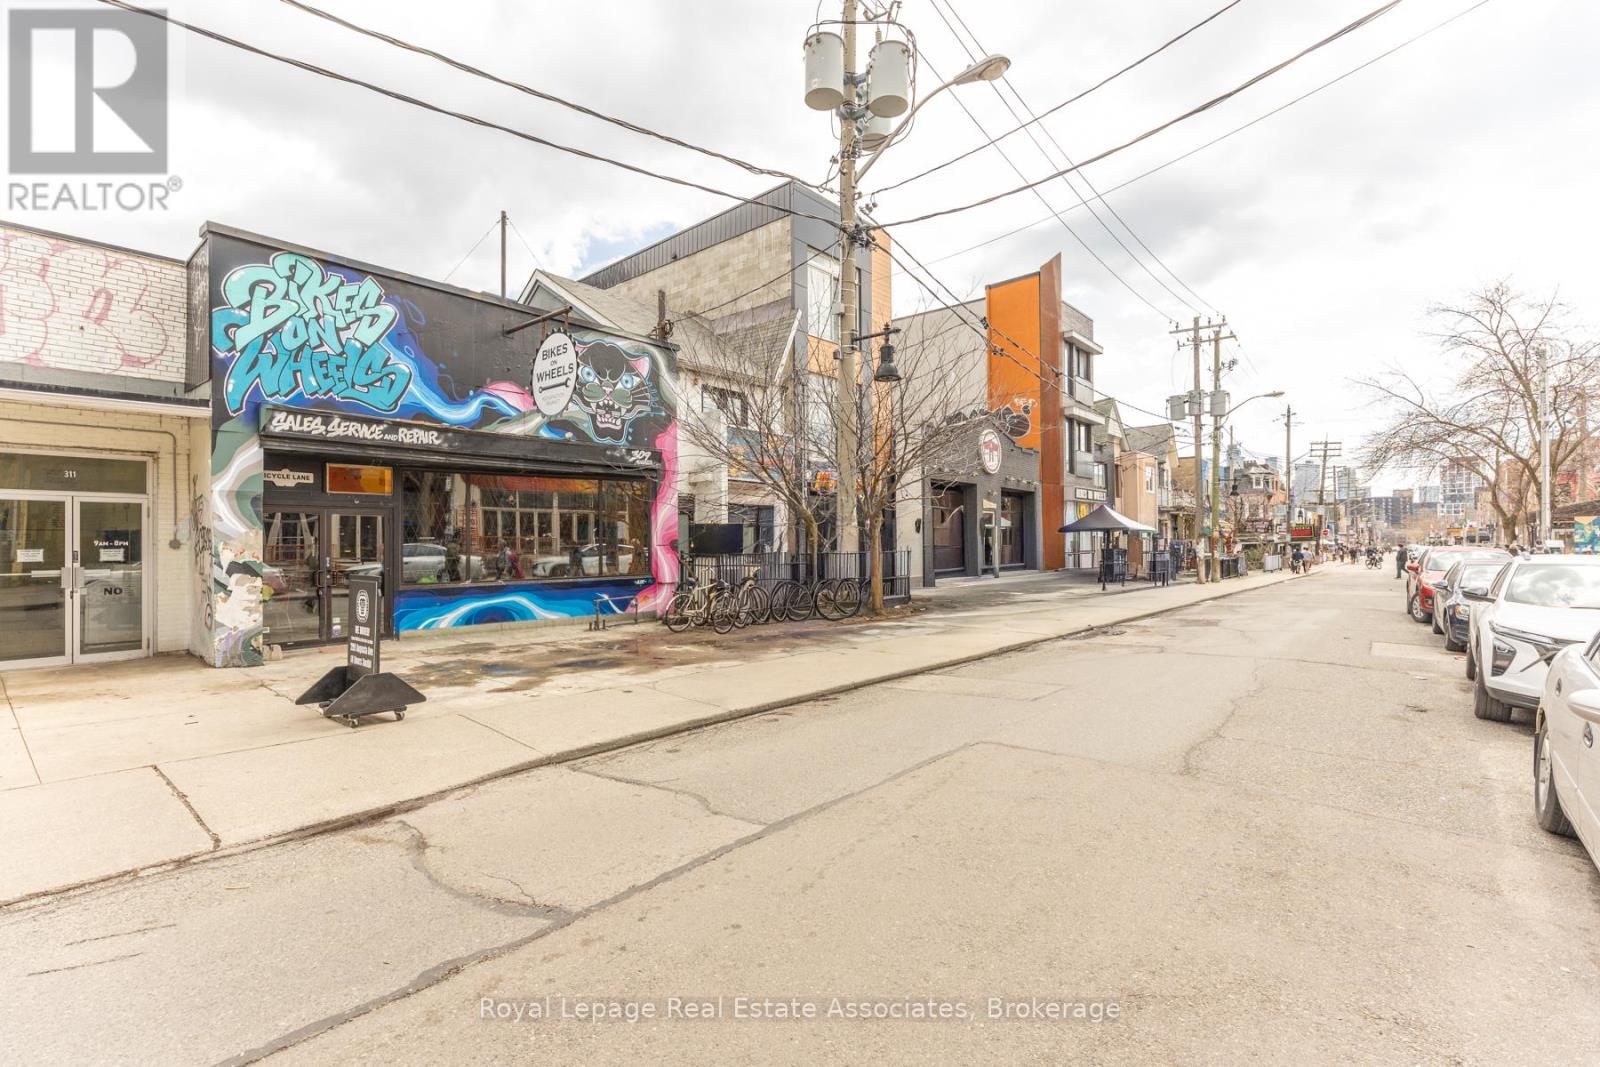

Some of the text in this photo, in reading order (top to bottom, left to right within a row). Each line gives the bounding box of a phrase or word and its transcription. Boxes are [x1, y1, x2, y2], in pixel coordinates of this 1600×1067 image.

[222, 252, 399, 351] BIKES
[280, 315, 343, 355] ON
[212, 308, 412, 414] WHEELS
[542, 343, 568, 360] BIKES
[537, 363, 574, 383] WHEELS
[326, 417, 385, 440] SERVICE
[383, 433, 399, 442] AND
[398, 427, 443, 446] REPAIR
[63, 470, 77, 478] 311
[292, 474, 311, 482] LANE
[103, 587, 123, 596] NO
